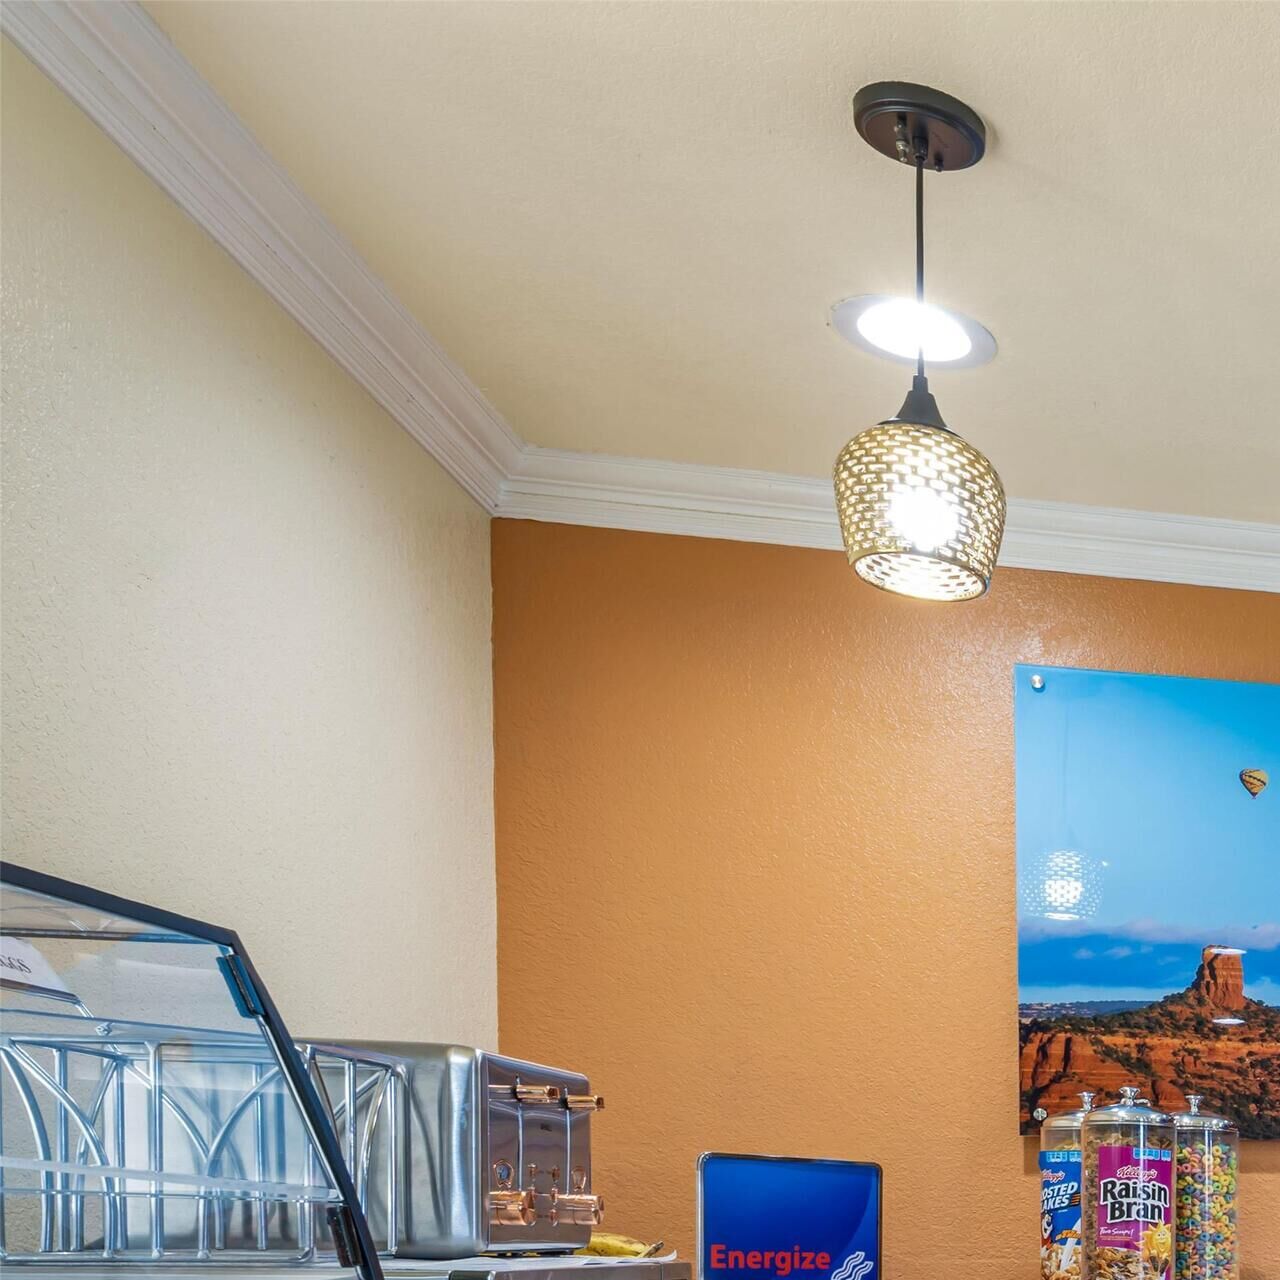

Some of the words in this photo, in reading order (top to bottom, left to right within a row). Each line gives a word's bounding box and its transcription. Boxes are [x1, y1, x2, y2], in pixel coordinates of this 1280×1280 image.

[1101, 1179, 1169, 1206] Raisin
[1108, 1201, 1164, 1223] Bran
[710, 1244, 831, 1276] Energize
